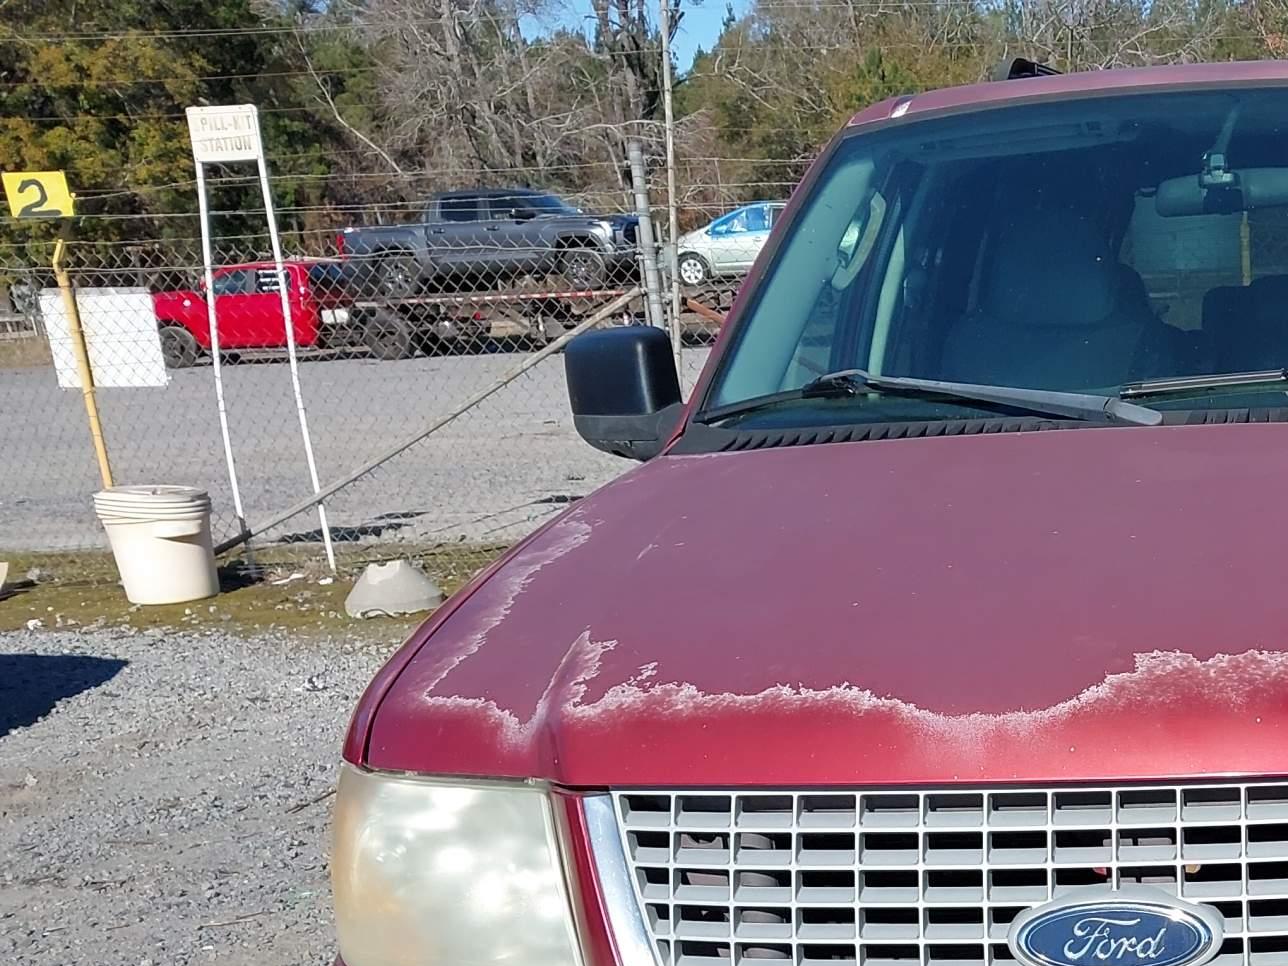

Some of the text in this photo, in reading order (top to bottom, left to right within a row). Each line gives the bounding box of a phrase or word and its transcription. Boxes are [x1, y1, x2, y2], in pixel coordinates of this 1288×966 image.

[200, 136, 252, 152] STATION
[17, 178, 63, 217] 2
[1063, 916, 1167, 960] Ford
